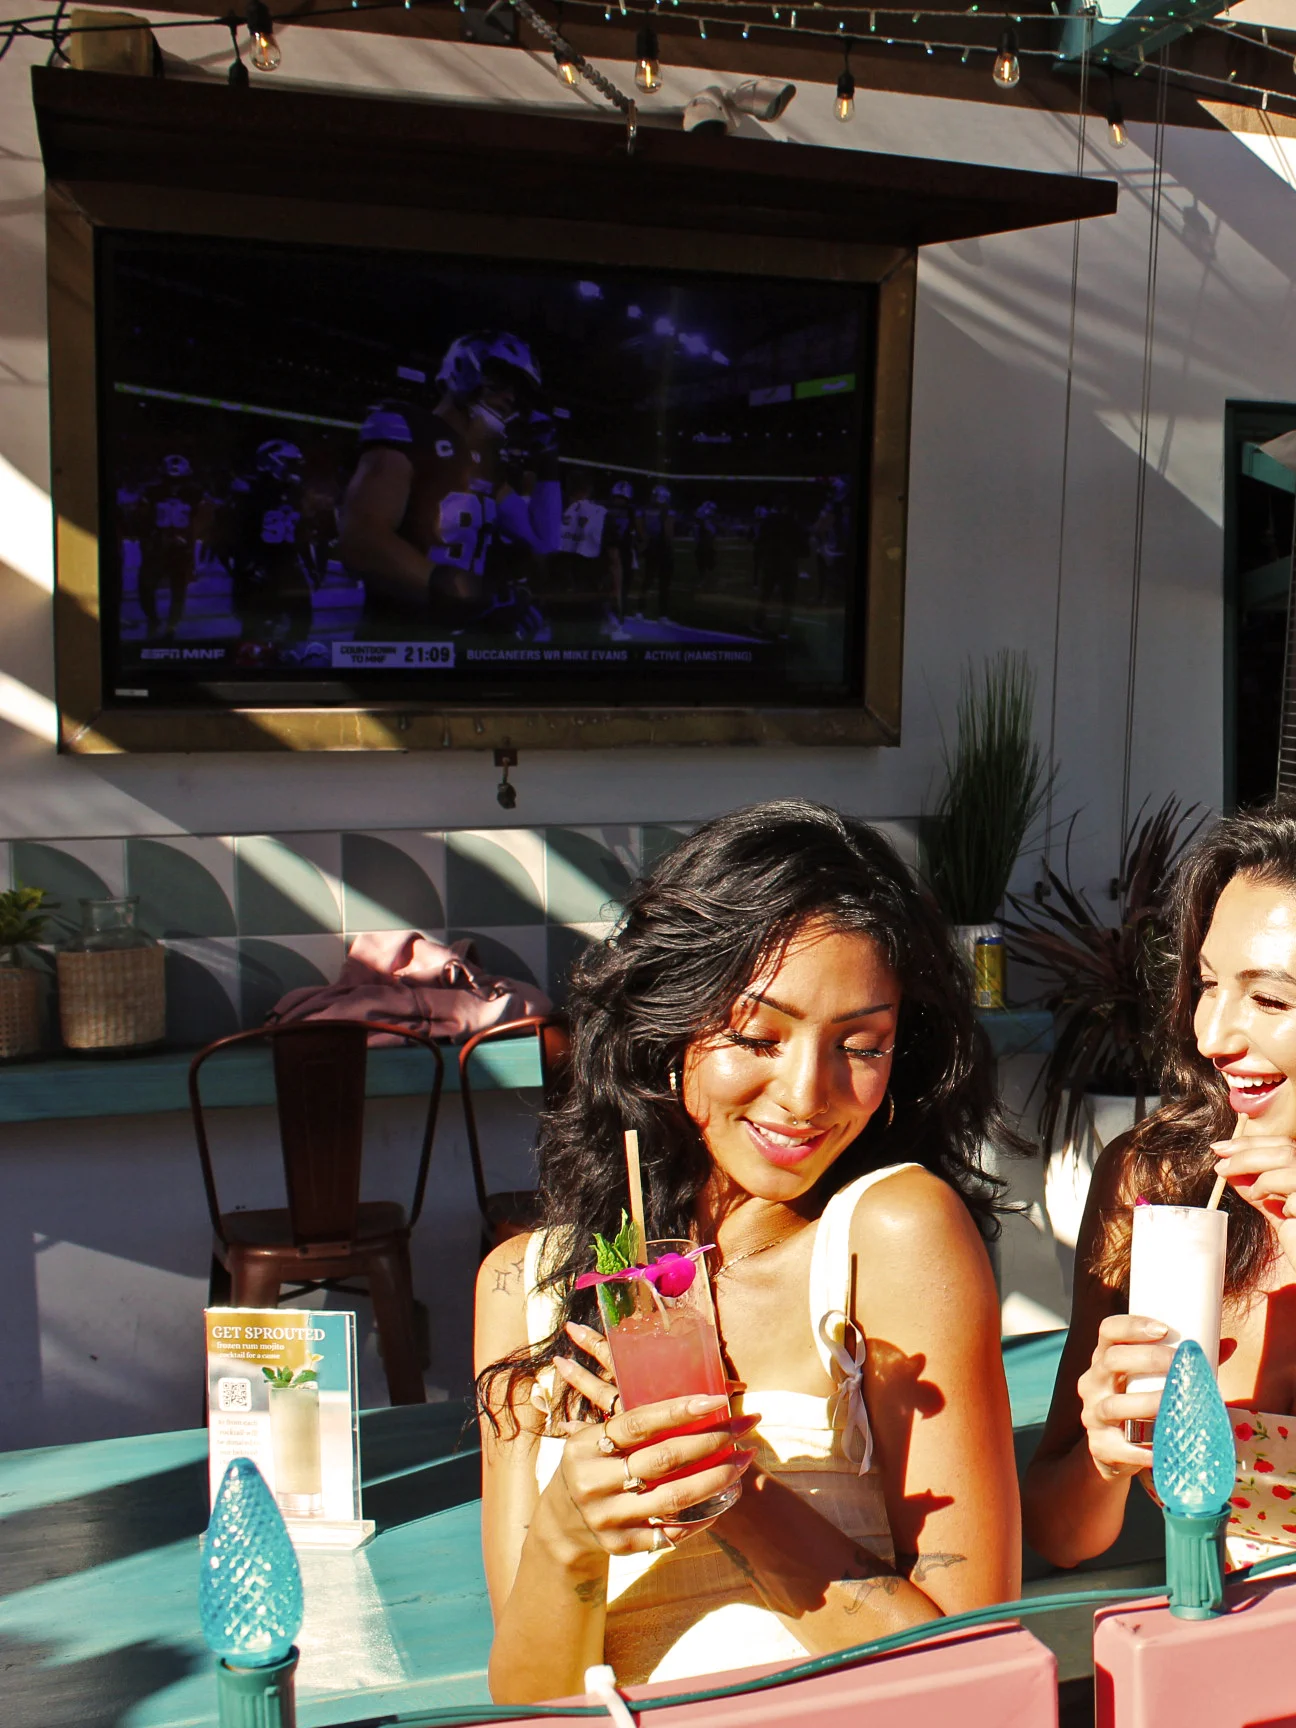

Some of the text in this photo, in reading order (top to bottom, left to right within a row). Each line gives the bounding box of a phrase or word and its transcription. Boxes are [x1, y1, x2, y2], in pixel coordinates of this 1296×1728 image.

[140, 648, 226, 660] ESPN MNF
[351, 655, 364, 664] TO
[404, 646, 450, 663] 21:09
[466, 649, 752, 663] BUCCANEERS WR MIKE EVANS ACTIVE (HAMSTRING)
[211, 1326, 326, 1341] GET SPROUTED
[216, 1341, 241, 1350] frozen
[260, 1342, 286, 1351] mojito
[219, 1351, 245, 1359] cocktail
[246, 1351, 256, 1359] for
